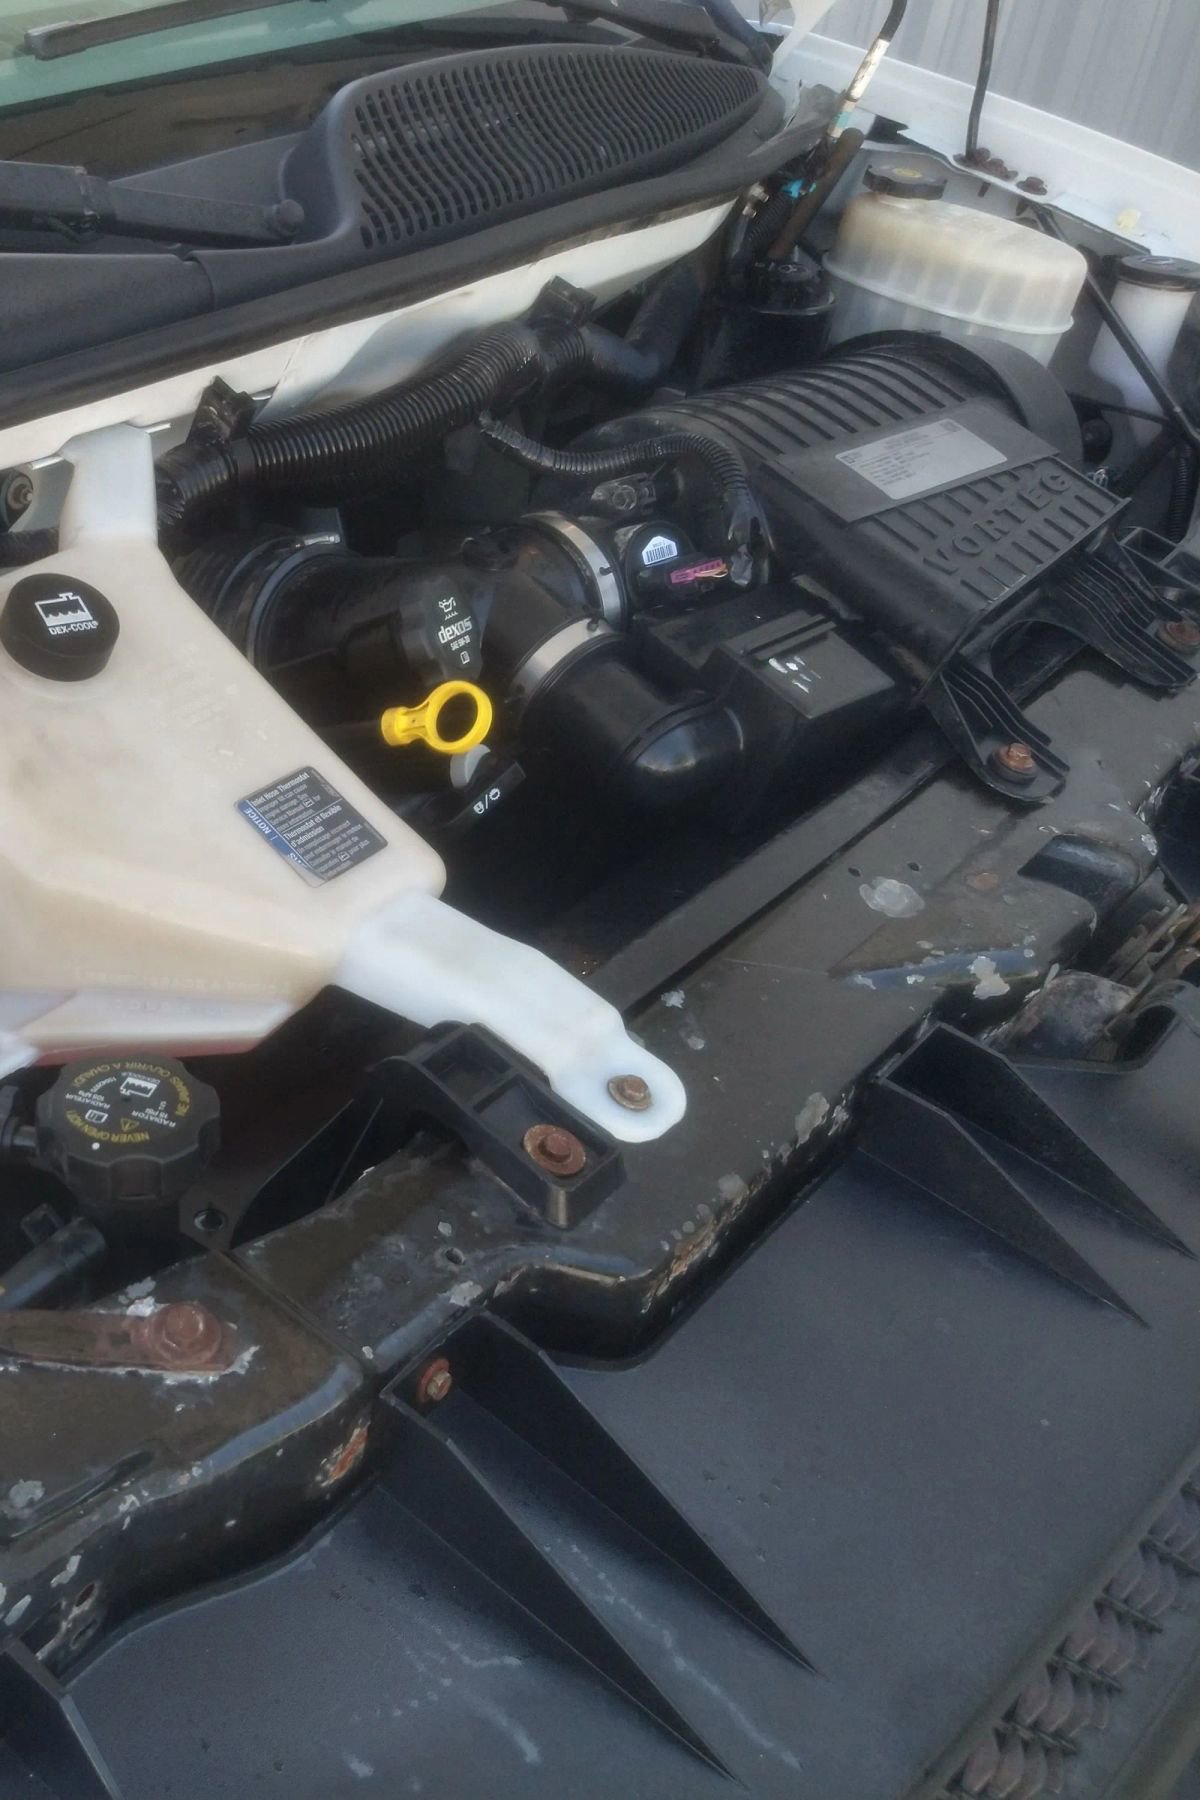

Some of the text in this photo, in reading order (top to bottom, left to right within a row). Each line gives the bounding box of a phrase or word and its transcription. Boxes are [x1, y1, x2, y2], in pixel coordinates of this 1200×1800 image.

[923, 468, 1072, 577] VORTEC
[438, 616, 472, 643] dexos
[277, 772, 310, 792] Thermostat
[244, 807, 271, 834] NOTICE
[283, 820, 315, 839] Thermostat
[65, 1093, 111, 1109] RADIATEUR
[132, 1110, 176, 1127] RADIATOR
[111, 1132, 149, 1143] NEVER
